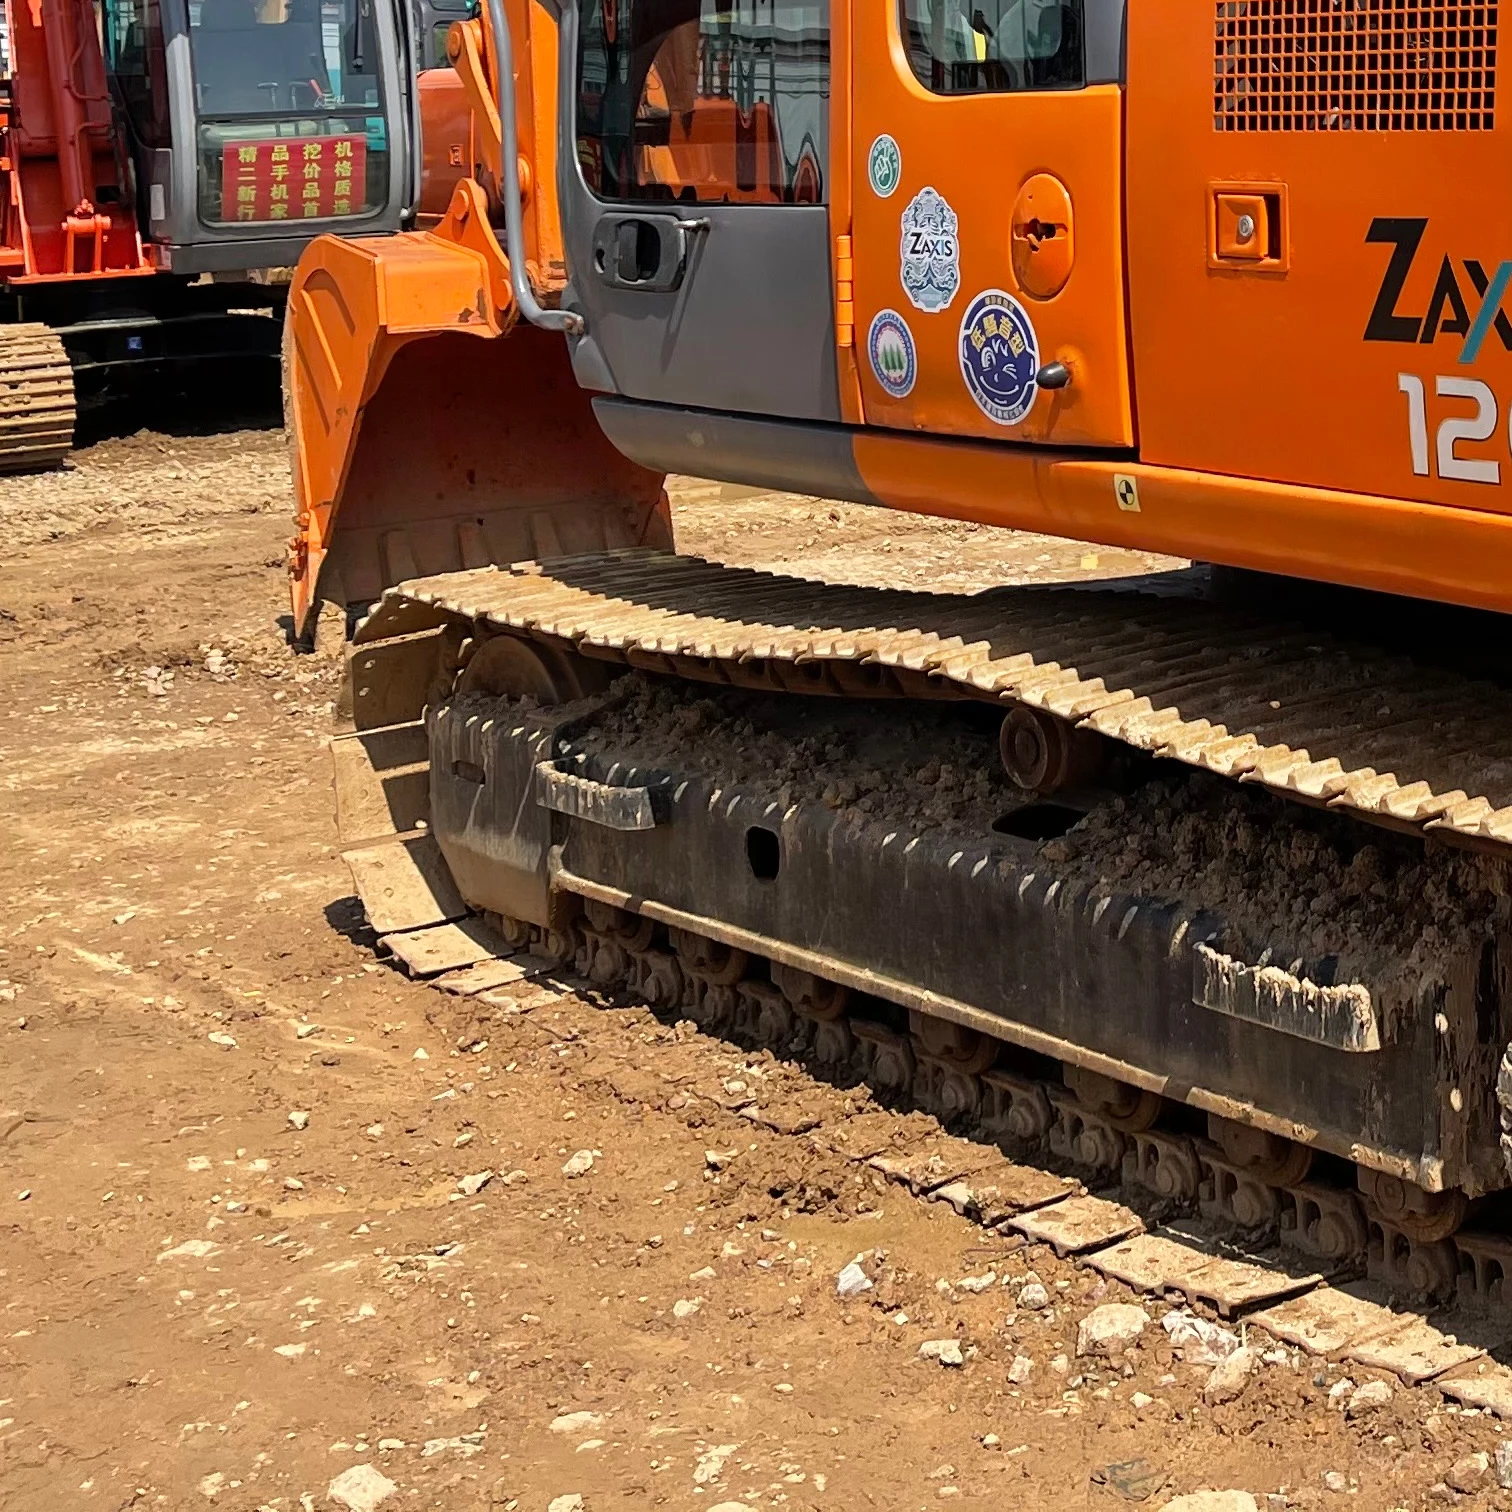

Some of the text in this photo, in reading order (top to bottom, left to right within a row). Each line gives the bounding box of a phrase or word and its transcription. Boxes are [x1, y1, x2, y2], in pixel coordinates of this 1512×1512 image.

[238, 141, 353, 163] 精品挖机
[237, 160, 352, 181] 二手价格
[237, 179, 352, 202] 新机品质
[909, 232, 953, 259] ZAXIS
